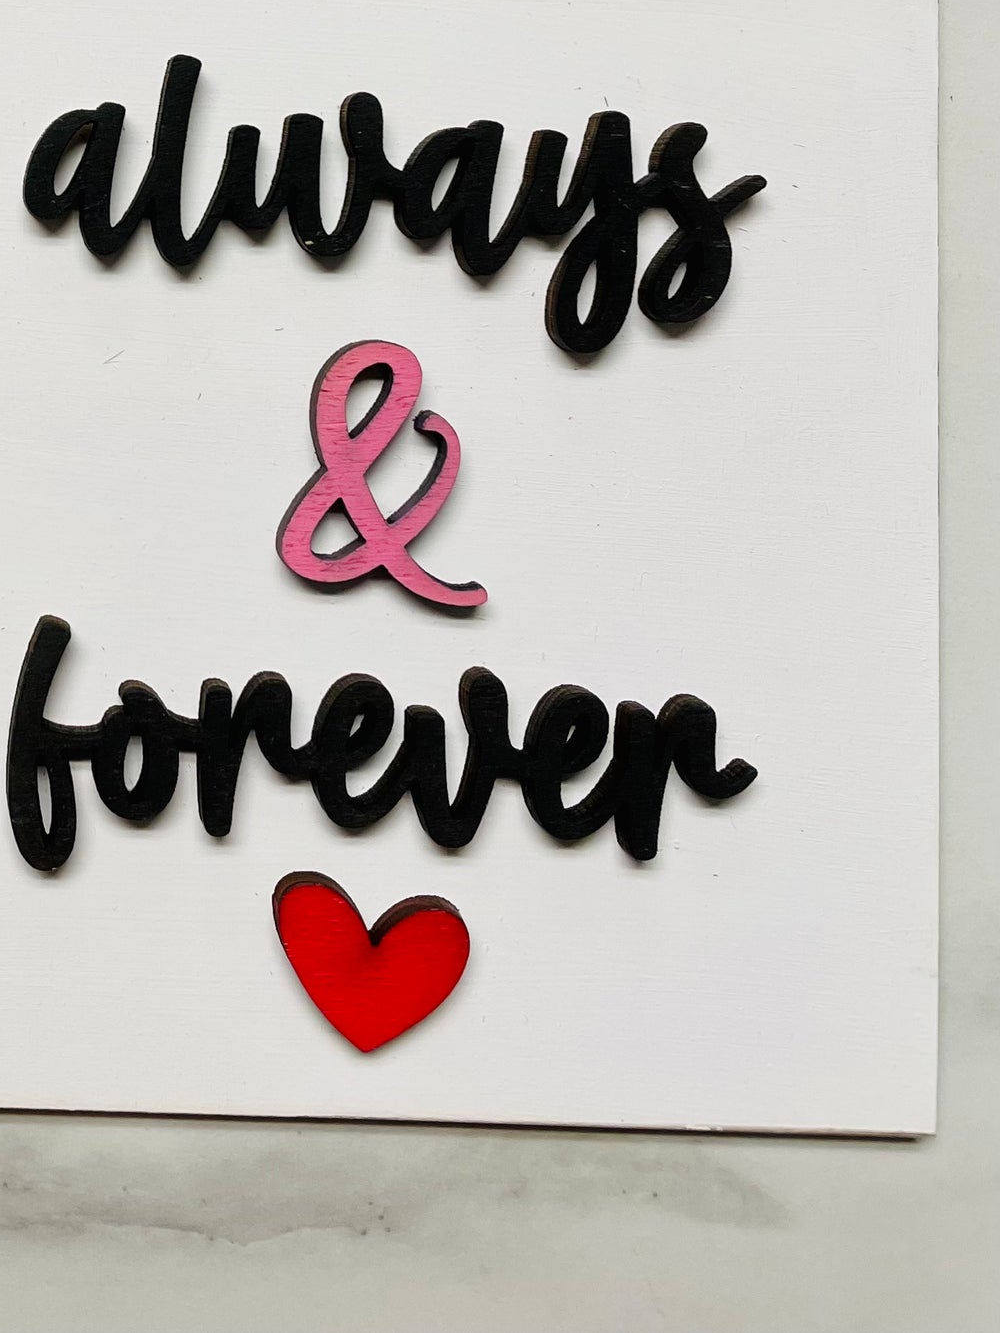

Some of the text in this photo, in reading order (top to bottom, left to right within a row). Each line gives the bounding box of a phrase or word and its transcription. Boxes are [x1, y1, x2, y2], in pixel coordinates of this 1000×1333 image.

[23, 55, 767, 360] always
[276, 340, 487, 615] &
[6, 615, 757, 873] forever
